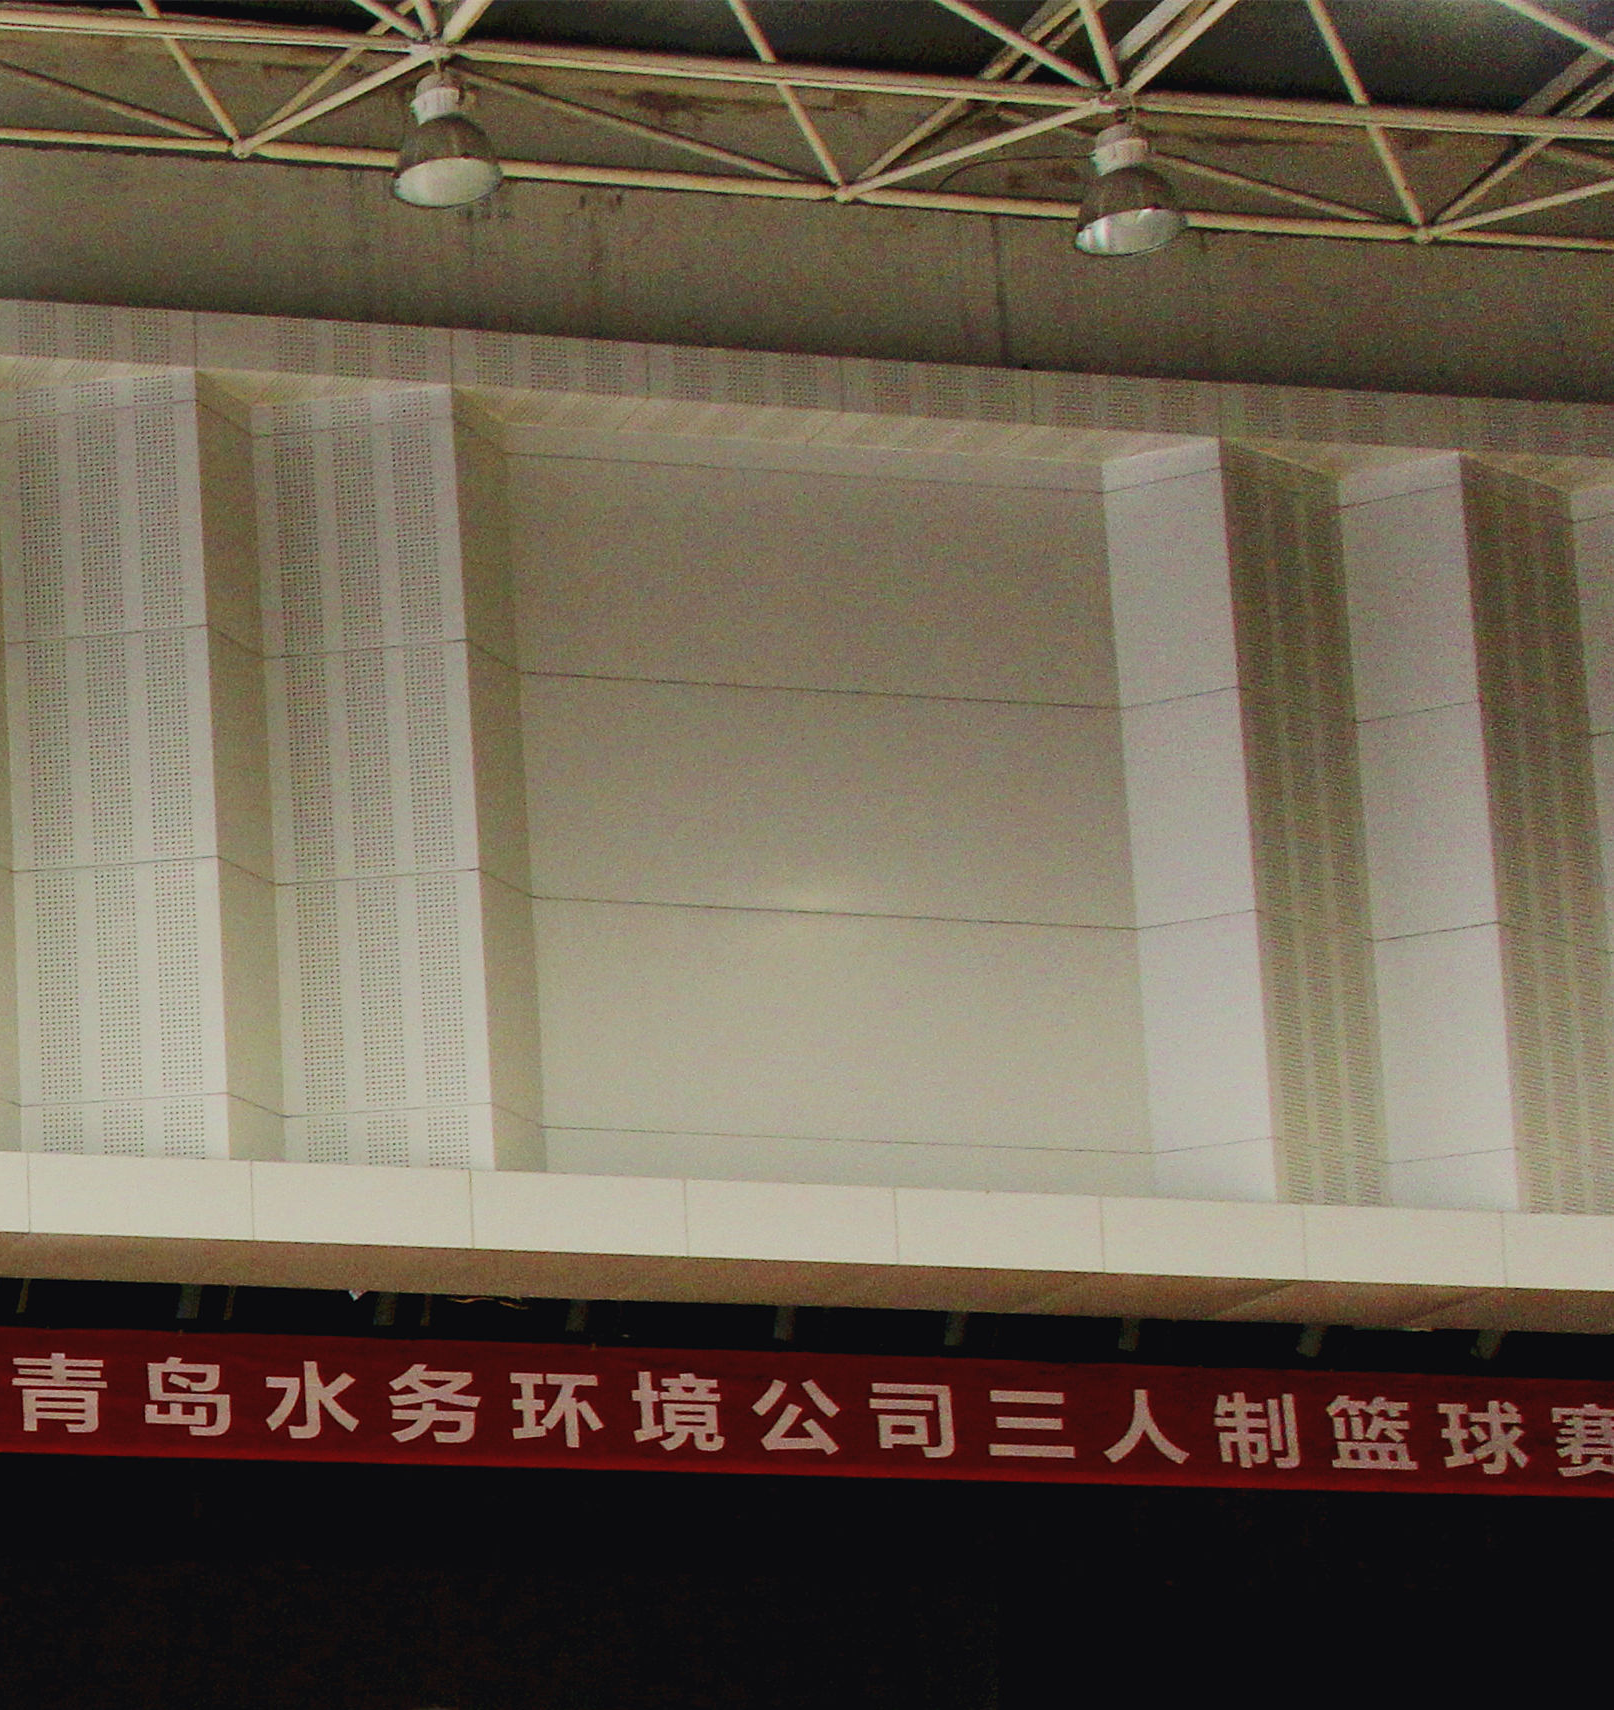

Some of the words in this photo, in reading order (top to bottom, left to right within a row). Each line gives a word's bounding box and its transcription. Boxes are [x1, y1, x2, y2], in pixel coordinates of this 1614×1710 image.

[11, 1351, 1614, 1477] 青岛水务环境公司三人制篮球赛
